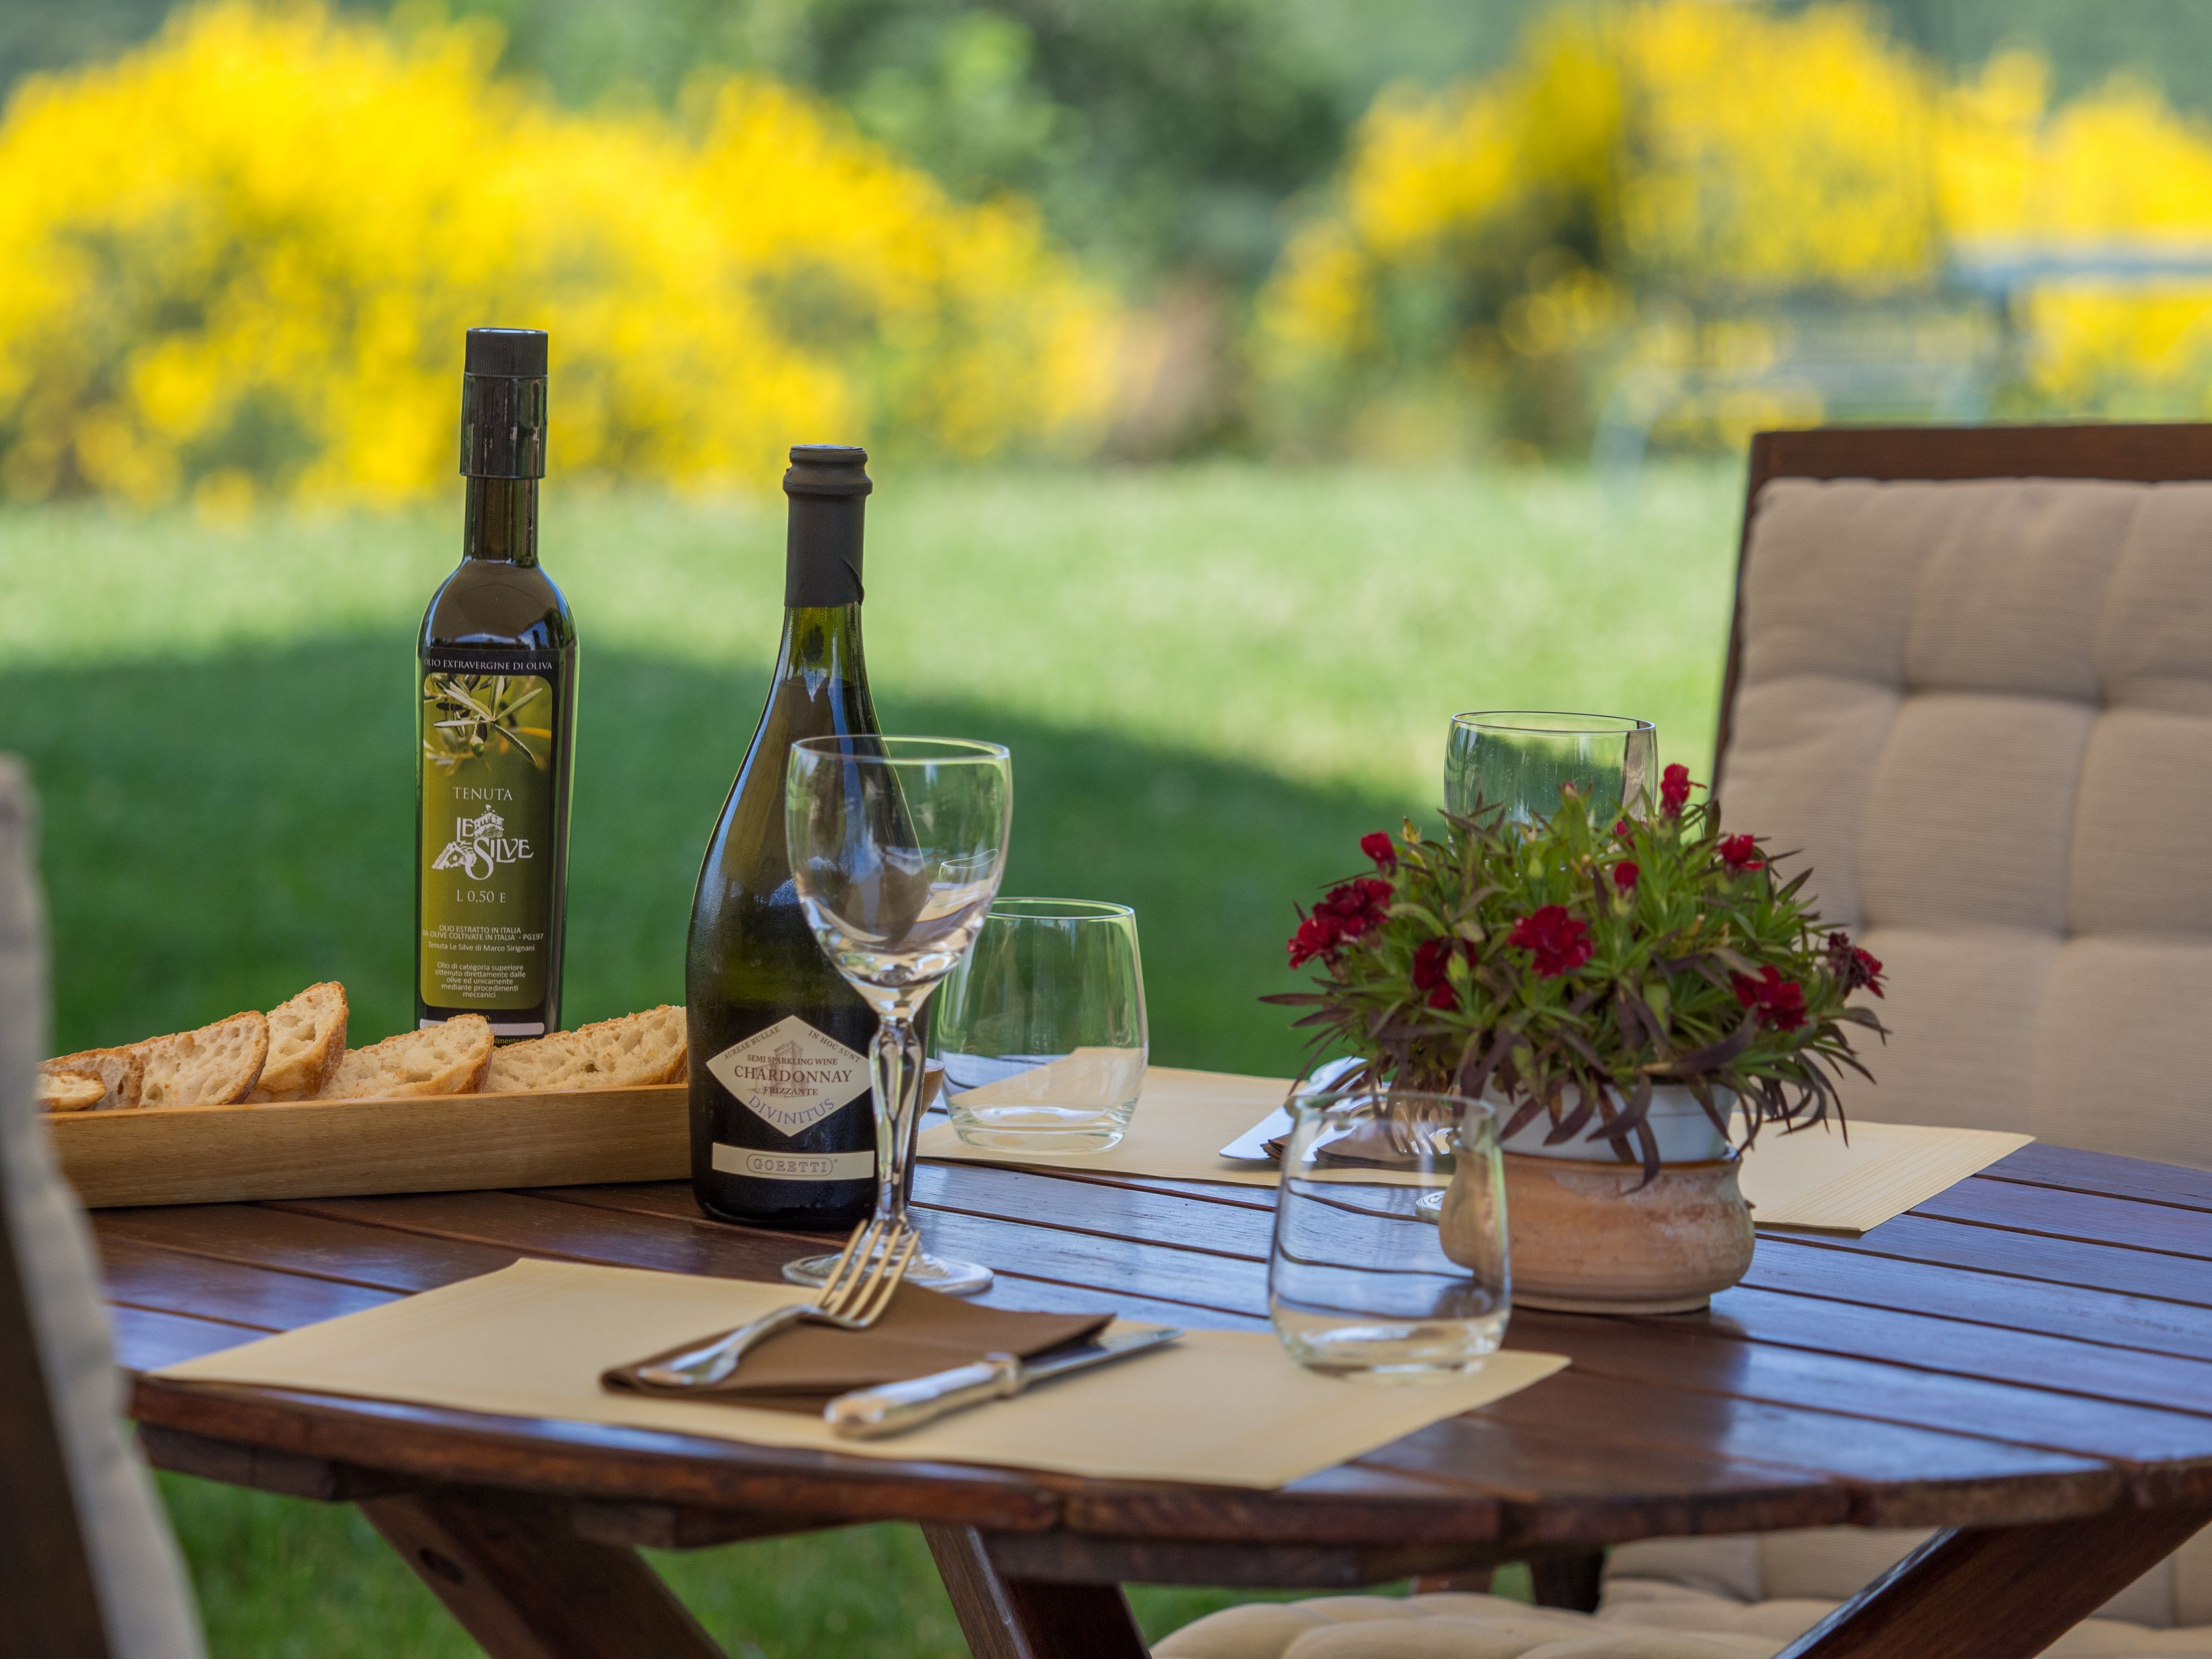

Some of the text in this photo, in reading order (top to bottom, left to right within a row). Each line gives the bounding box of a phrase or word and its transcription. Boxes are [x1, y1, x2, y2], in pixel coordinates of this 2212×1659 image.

[424, 658, 552, 671] OLIO EXTRAVERGINE DI OLIVA
[453, 787, 513, 801] TENUTA
[457, 817, 475, 842] LE
[465, 837, 534, 881] SILVE
[457, 889, 463, 902] L
[467, 891, 494, 903] 0,50
[430, 930, 447, 938] OLIVE
[456, 925, 490, 934] ESTRATTO
[428, 941, 448, 950] Tenuta
[507, 944, 535, 953] Sirignani
[459, 964, 490, 972] categoria
[474, 984, 518, 993] procedimenti
[724, 1027, 781, 1060] AUREAE BULLAE
[808, 1030, 861, 1063] IN HOC SUNT
[747, 1054, 766, 1063] SEMI
[767, 1056, 813, 1066] SPARKLING
[734, 1065, 853, 1083] CHARDONNAY
[764, 1086, 819, 1096] FRIZZANTE
[748, 1094, 835, 1124] DIVINITUS
[753, 1158, 827, 1173] GORETTI
